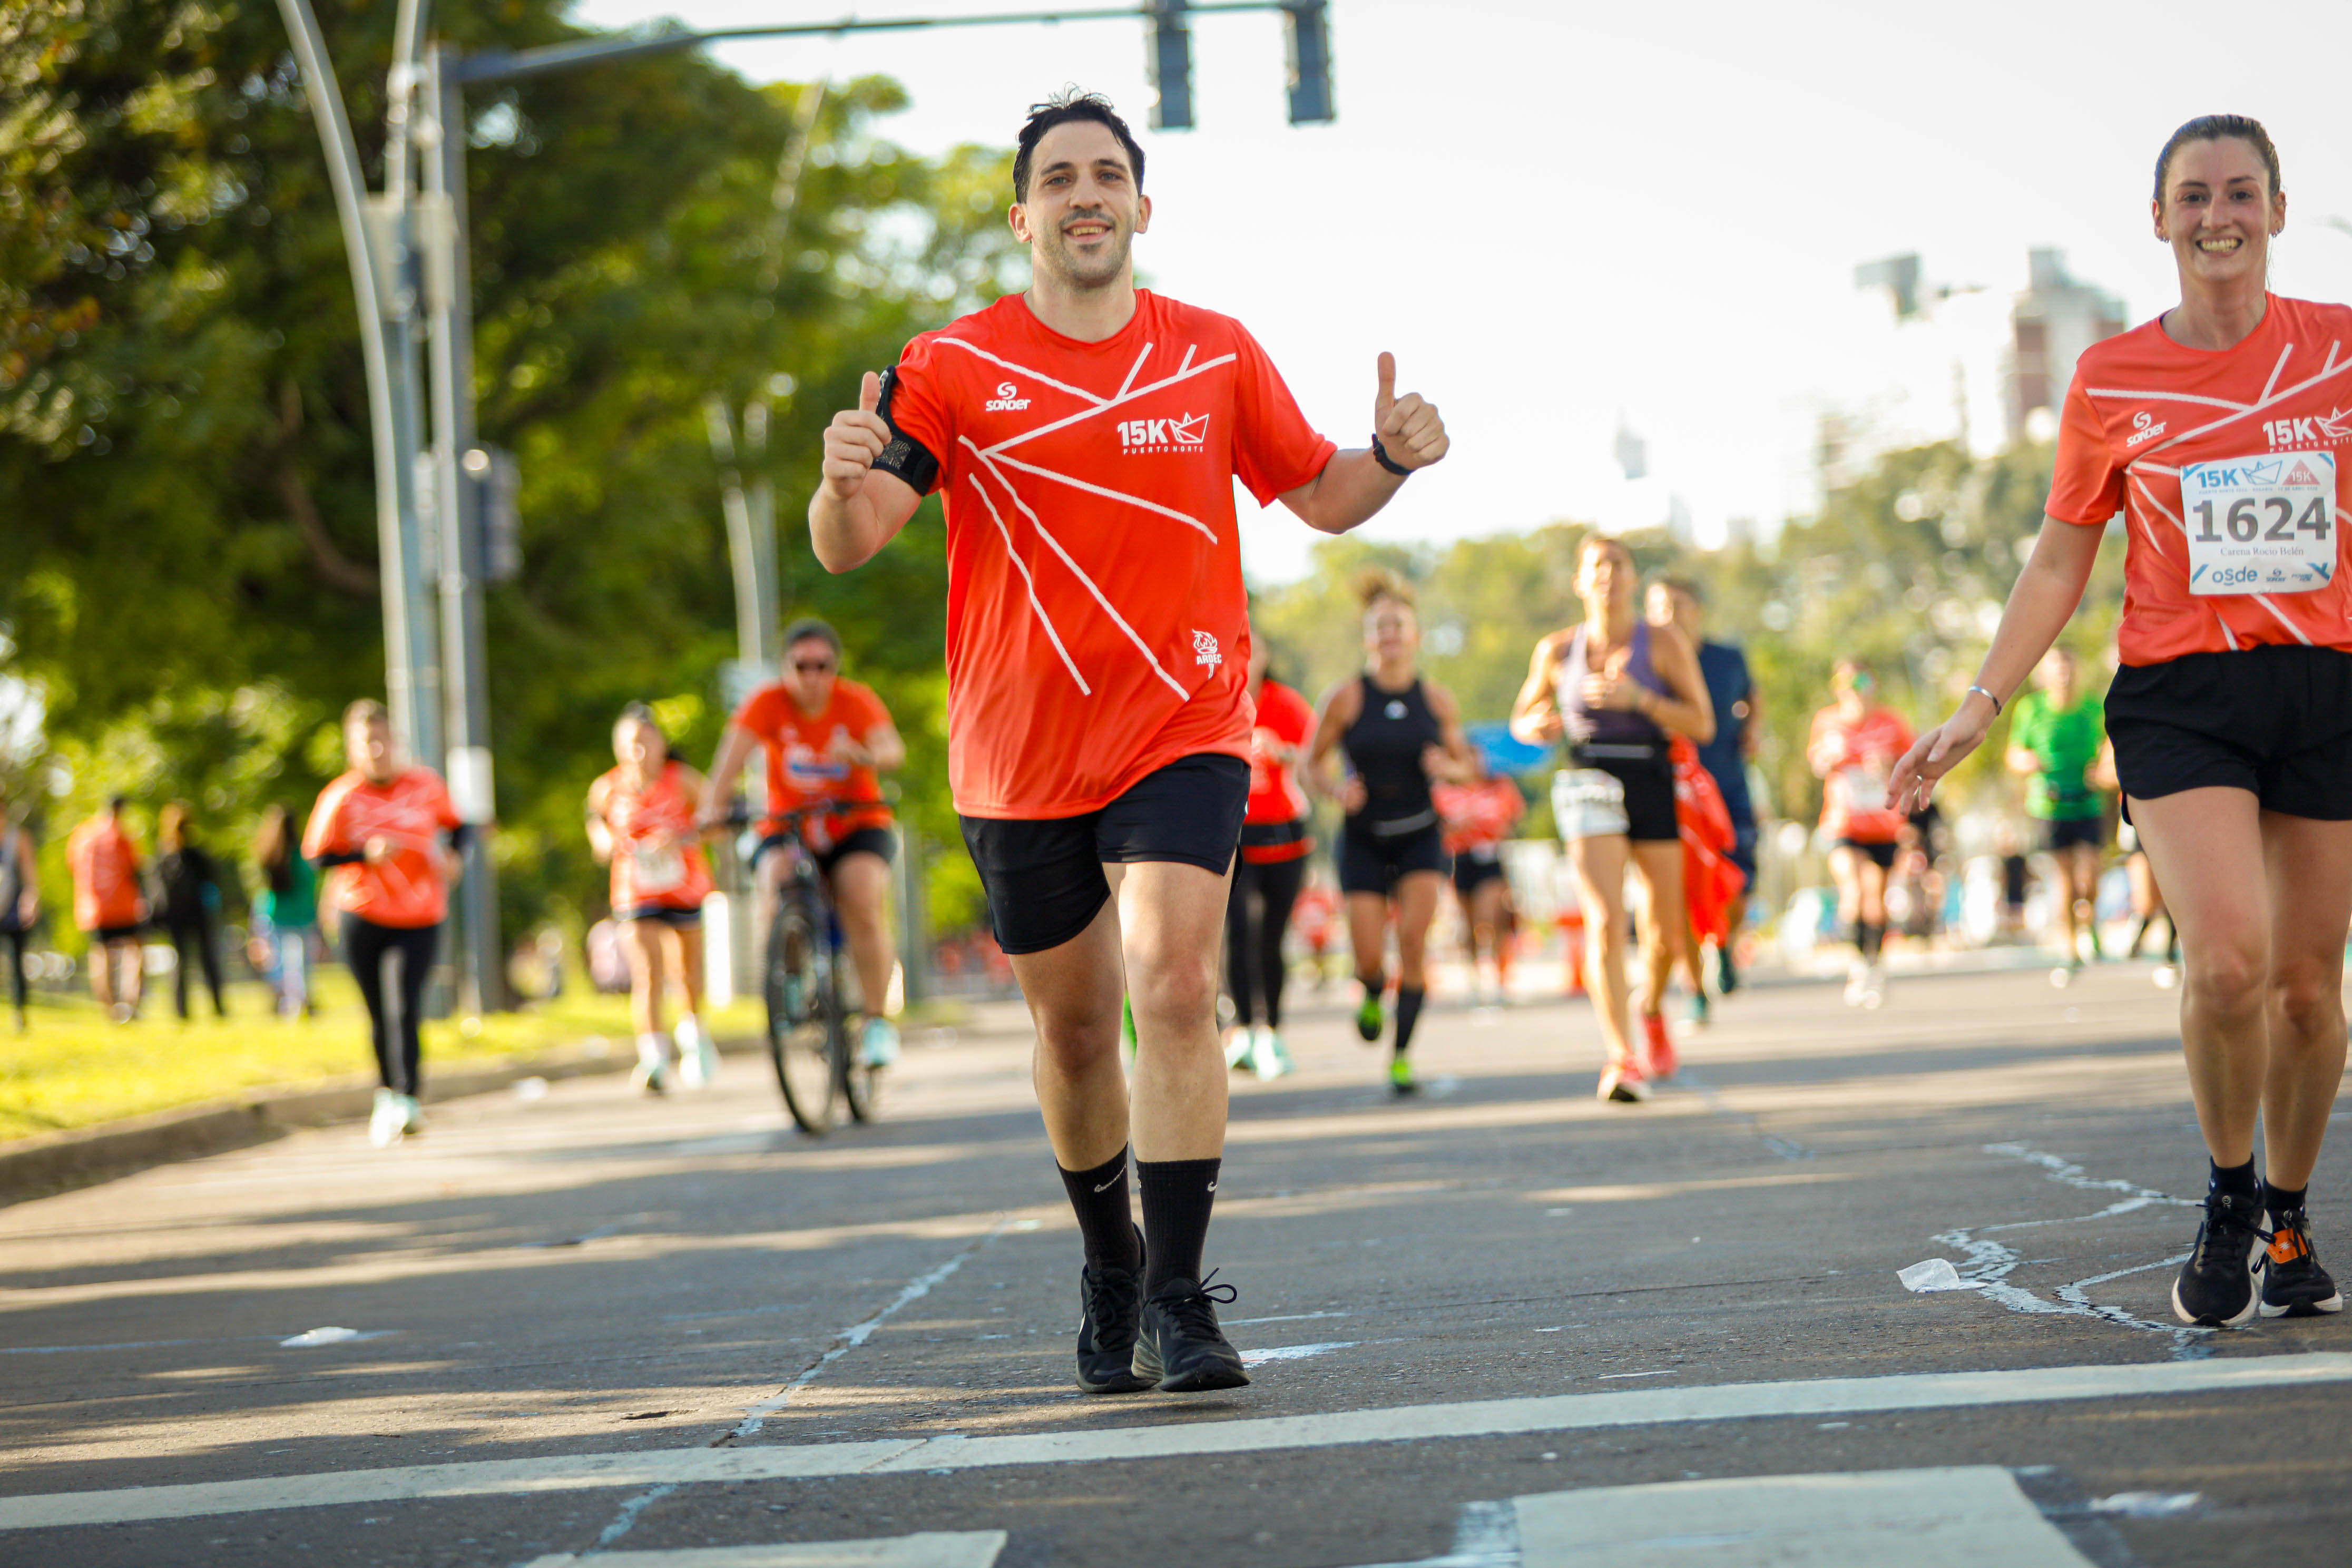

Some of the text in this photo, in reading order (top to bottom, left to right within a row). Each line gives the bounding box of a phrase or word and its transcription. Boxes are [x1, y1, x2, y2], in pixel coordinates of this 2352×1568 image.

[1118, 419, 1169, 446] 15K
[2262, 417, 2317, 446] 15K
[1123, 446, 1168, 455] PUERTO
[2269, 441, 2318, 453] PUERTO
[2197, 468, 2239, 488] 15K
[2291, 471, 2312, 482] 15K
[2192, 497, 2331, 542] 1624
[2212, 565, 2258, 584] osde
[1196, 653, 1222, 665] ARDEC
